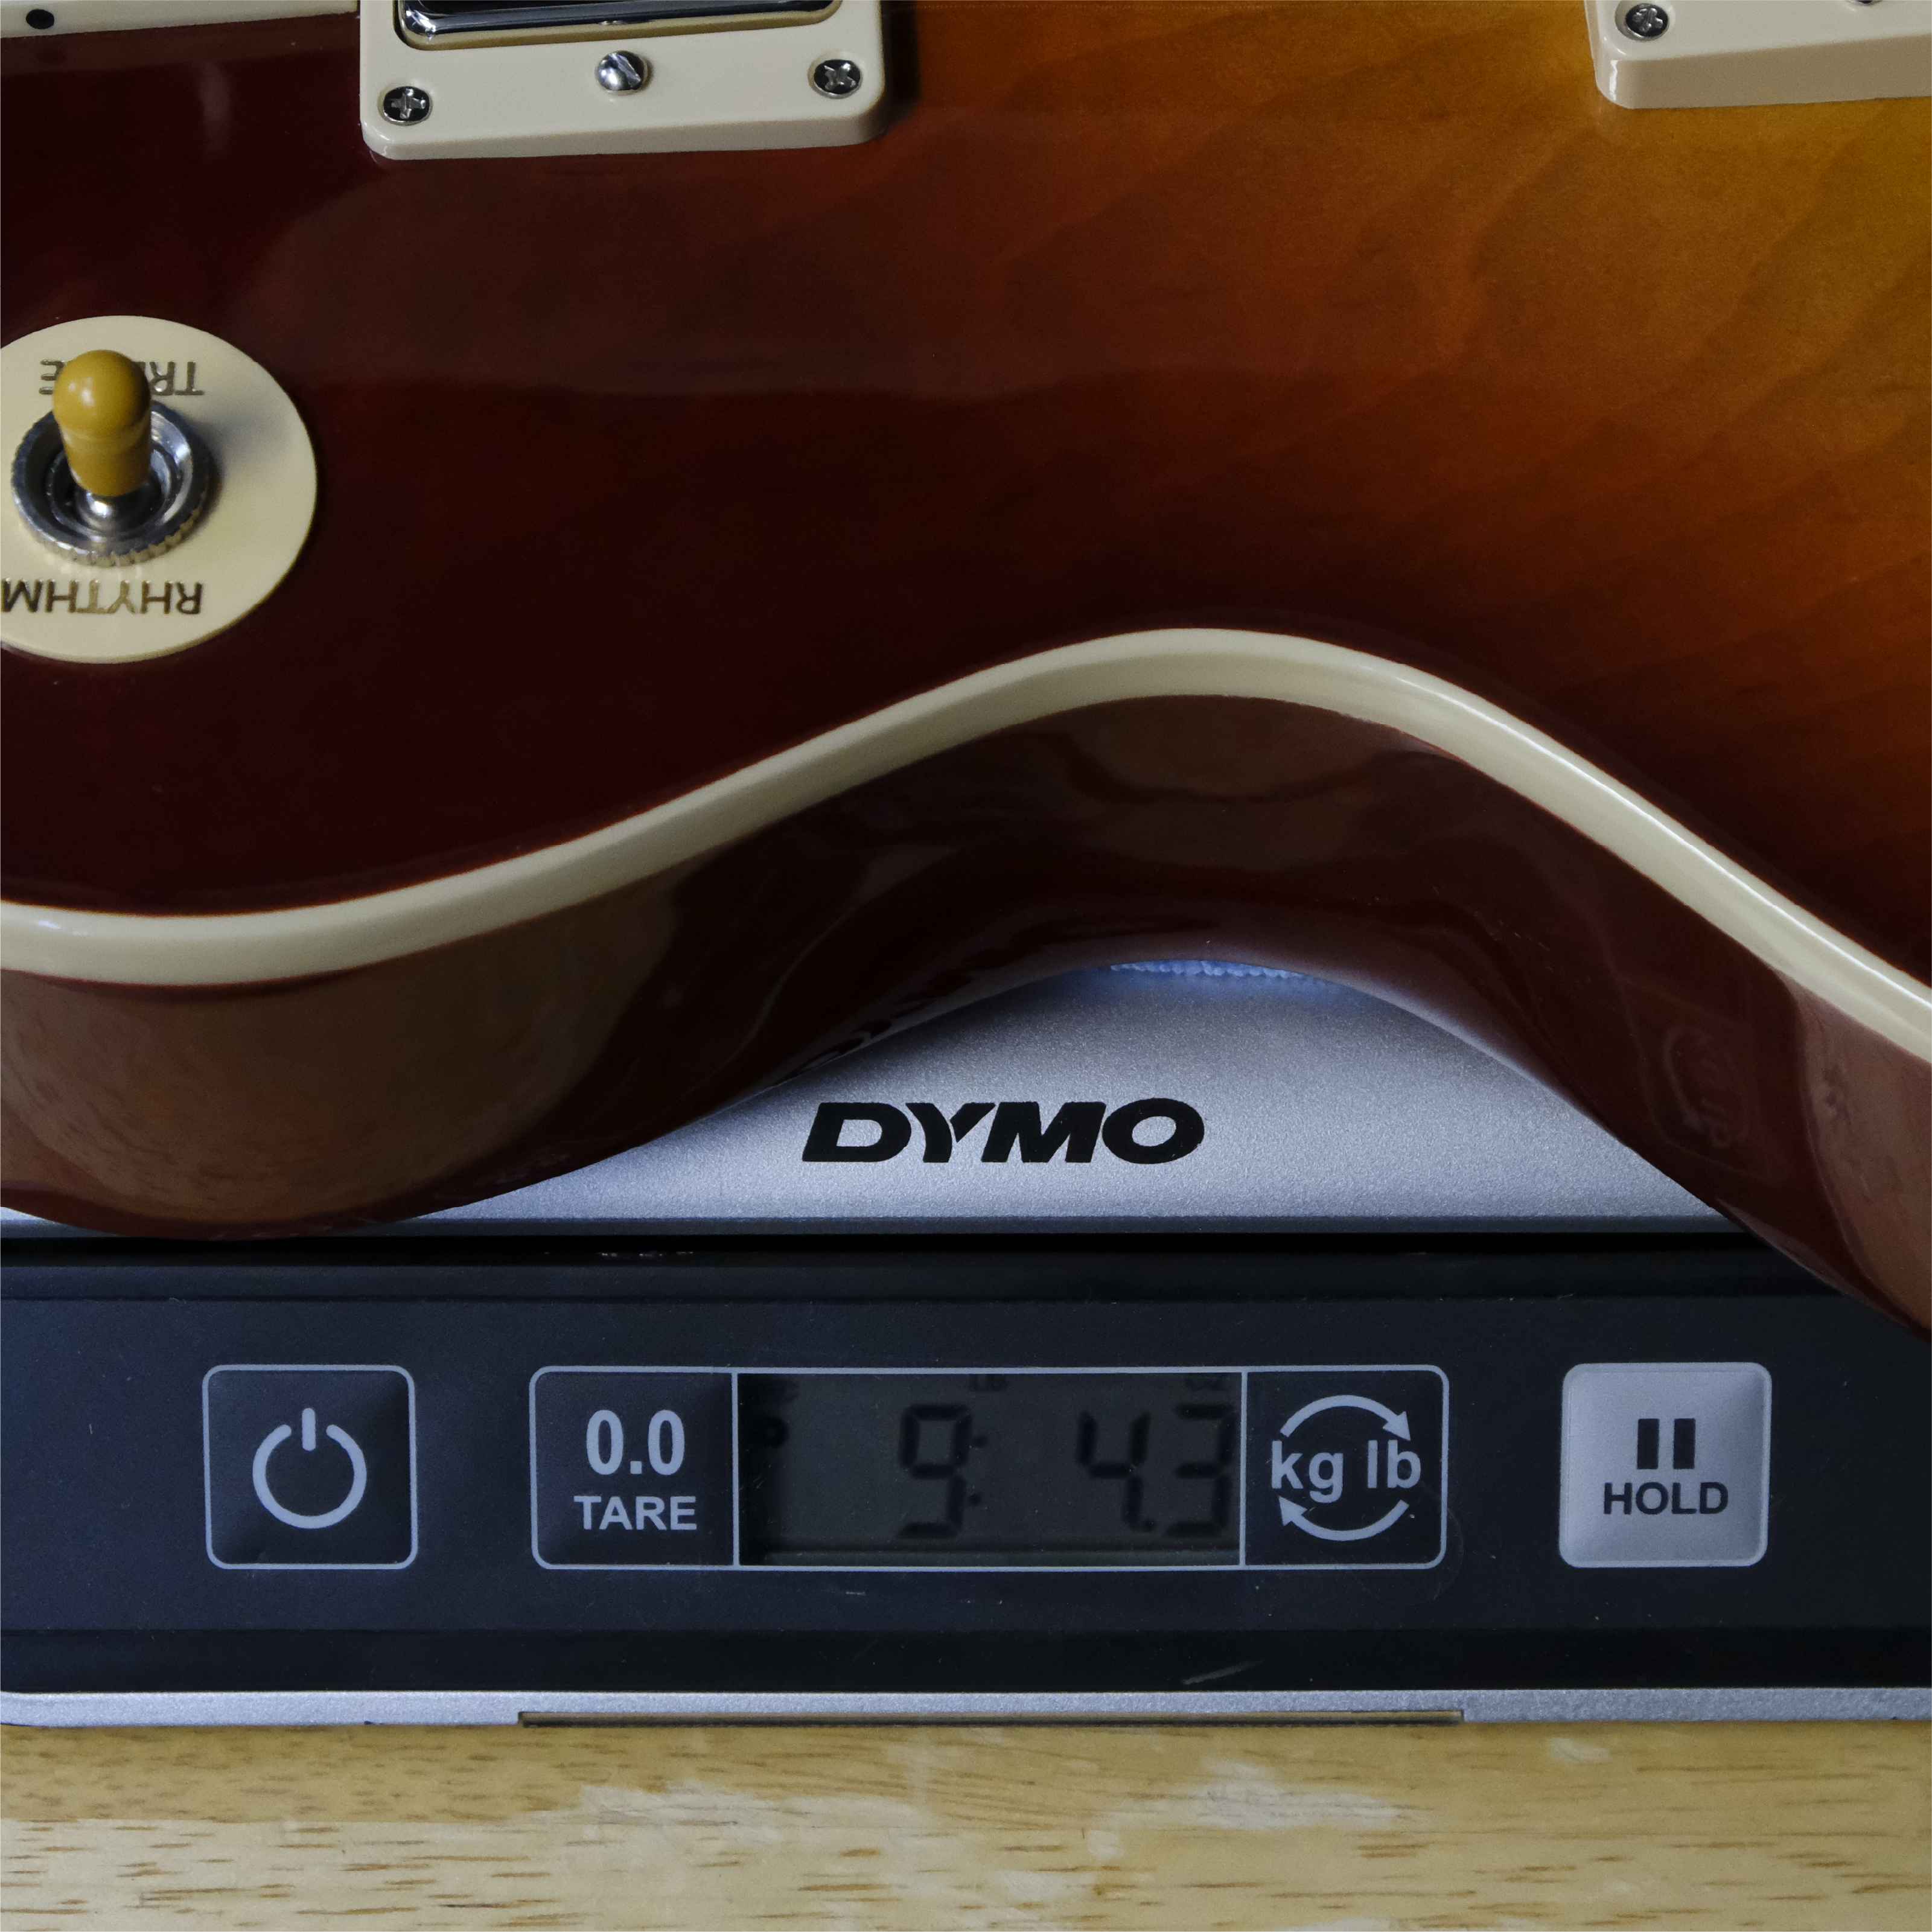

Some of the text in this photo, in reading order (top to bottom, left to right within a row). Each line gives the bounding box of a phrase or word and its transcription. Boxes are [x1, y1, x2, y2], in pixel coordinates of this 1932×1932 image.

[39, 360, 203, 396] TRE
[0, 578, 203, 615] RHYTHM
[802, 1098, 1205, 1164] DYMO
[586, 1409, 685, 1475] 0.0
[1271, 1439, 1421, 1503] kg lb
[573, 1496, 697, 1530] TARE
[1603, 1482, 1729, 1516] HOLD
